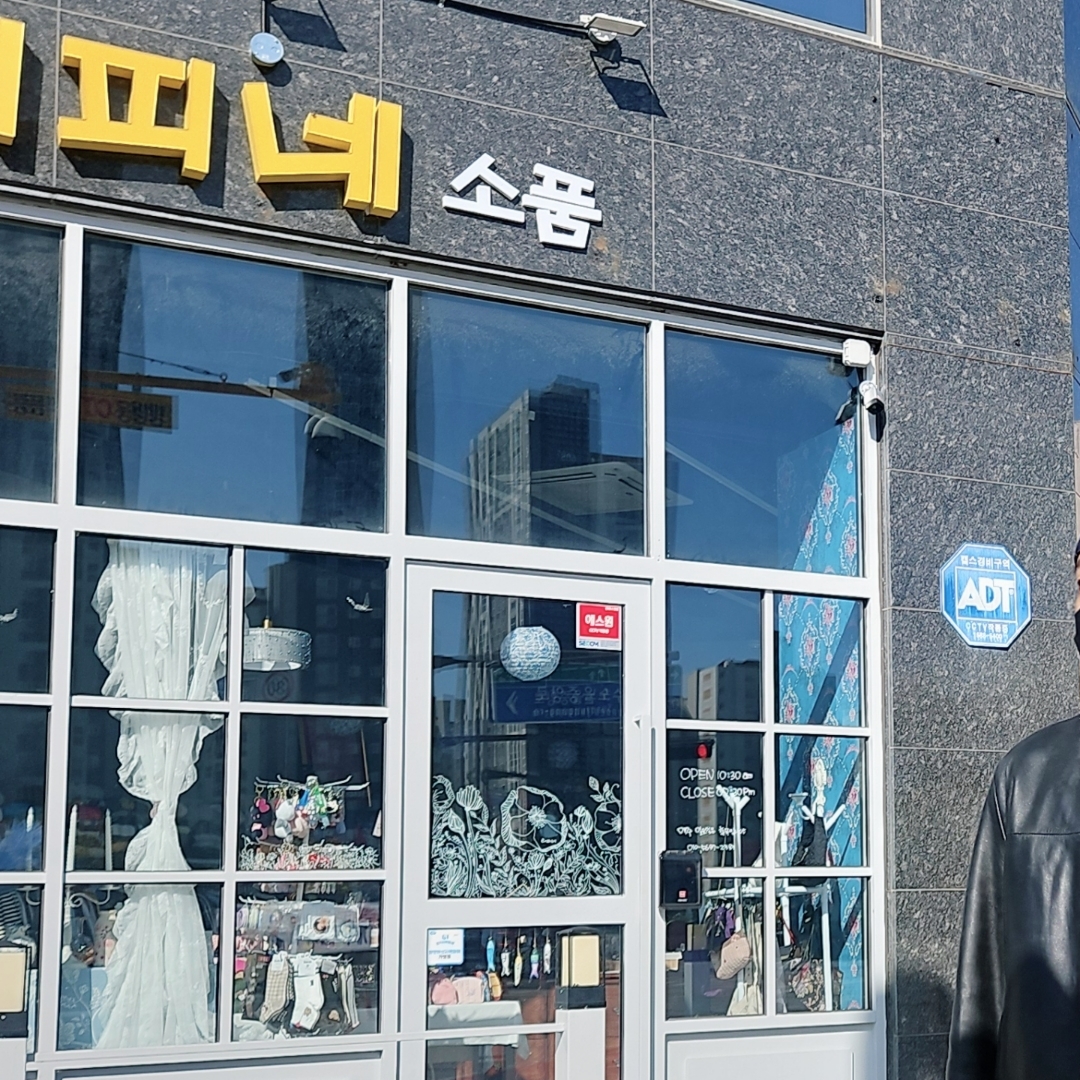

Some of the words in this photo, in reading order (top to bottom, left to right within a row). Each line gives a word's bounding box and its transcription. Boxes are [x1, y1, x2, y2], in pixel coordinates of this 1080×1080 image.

[442, 153, 603, 250] 소품
[957, 577, 1015, 613] ADT
[584, 613, 614, 629] 에스원
[680, 767, 715, 781] OPEN
[680, 786, 716, 800] CLOSE
